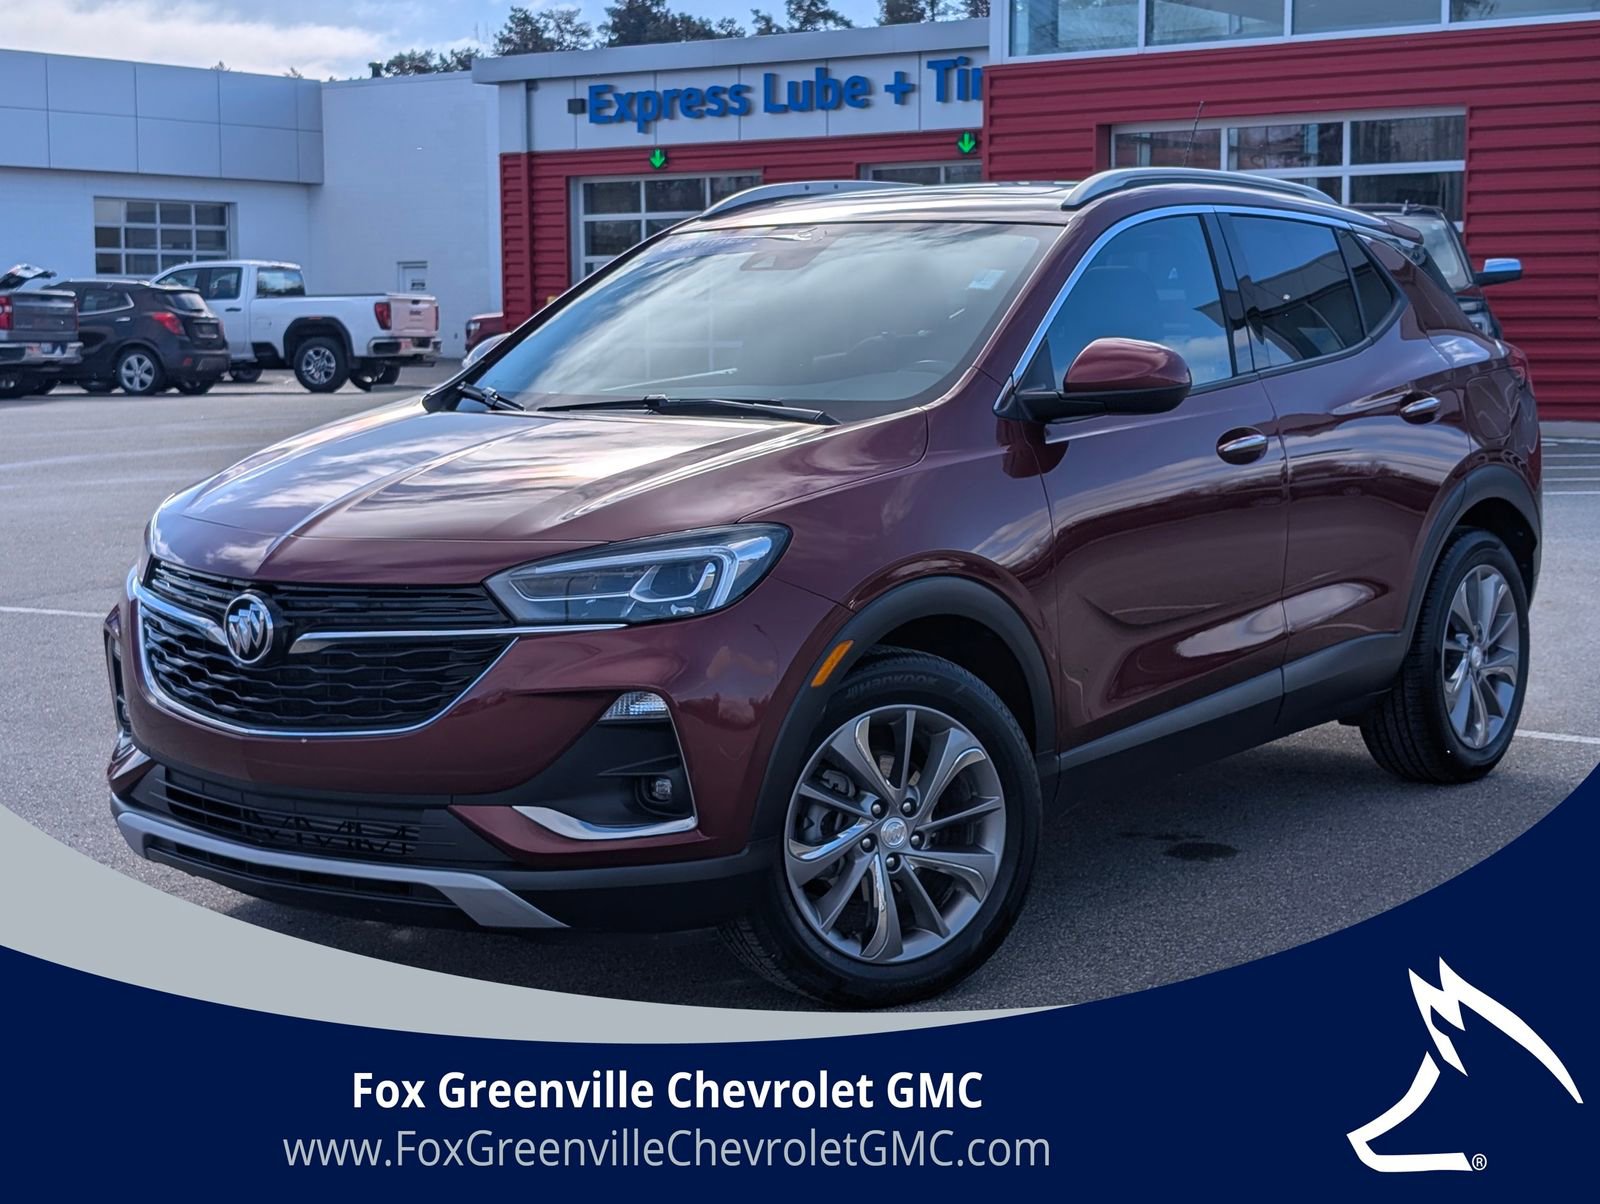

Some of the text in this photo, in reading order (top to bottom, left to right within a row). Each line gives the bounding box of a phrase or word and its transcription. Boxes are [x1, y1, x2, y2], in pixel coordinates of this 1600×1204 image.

[588, 83, 752, 133] Express
[763, 67, 872, 114] Lube
[885, 71, 916, 105] +
